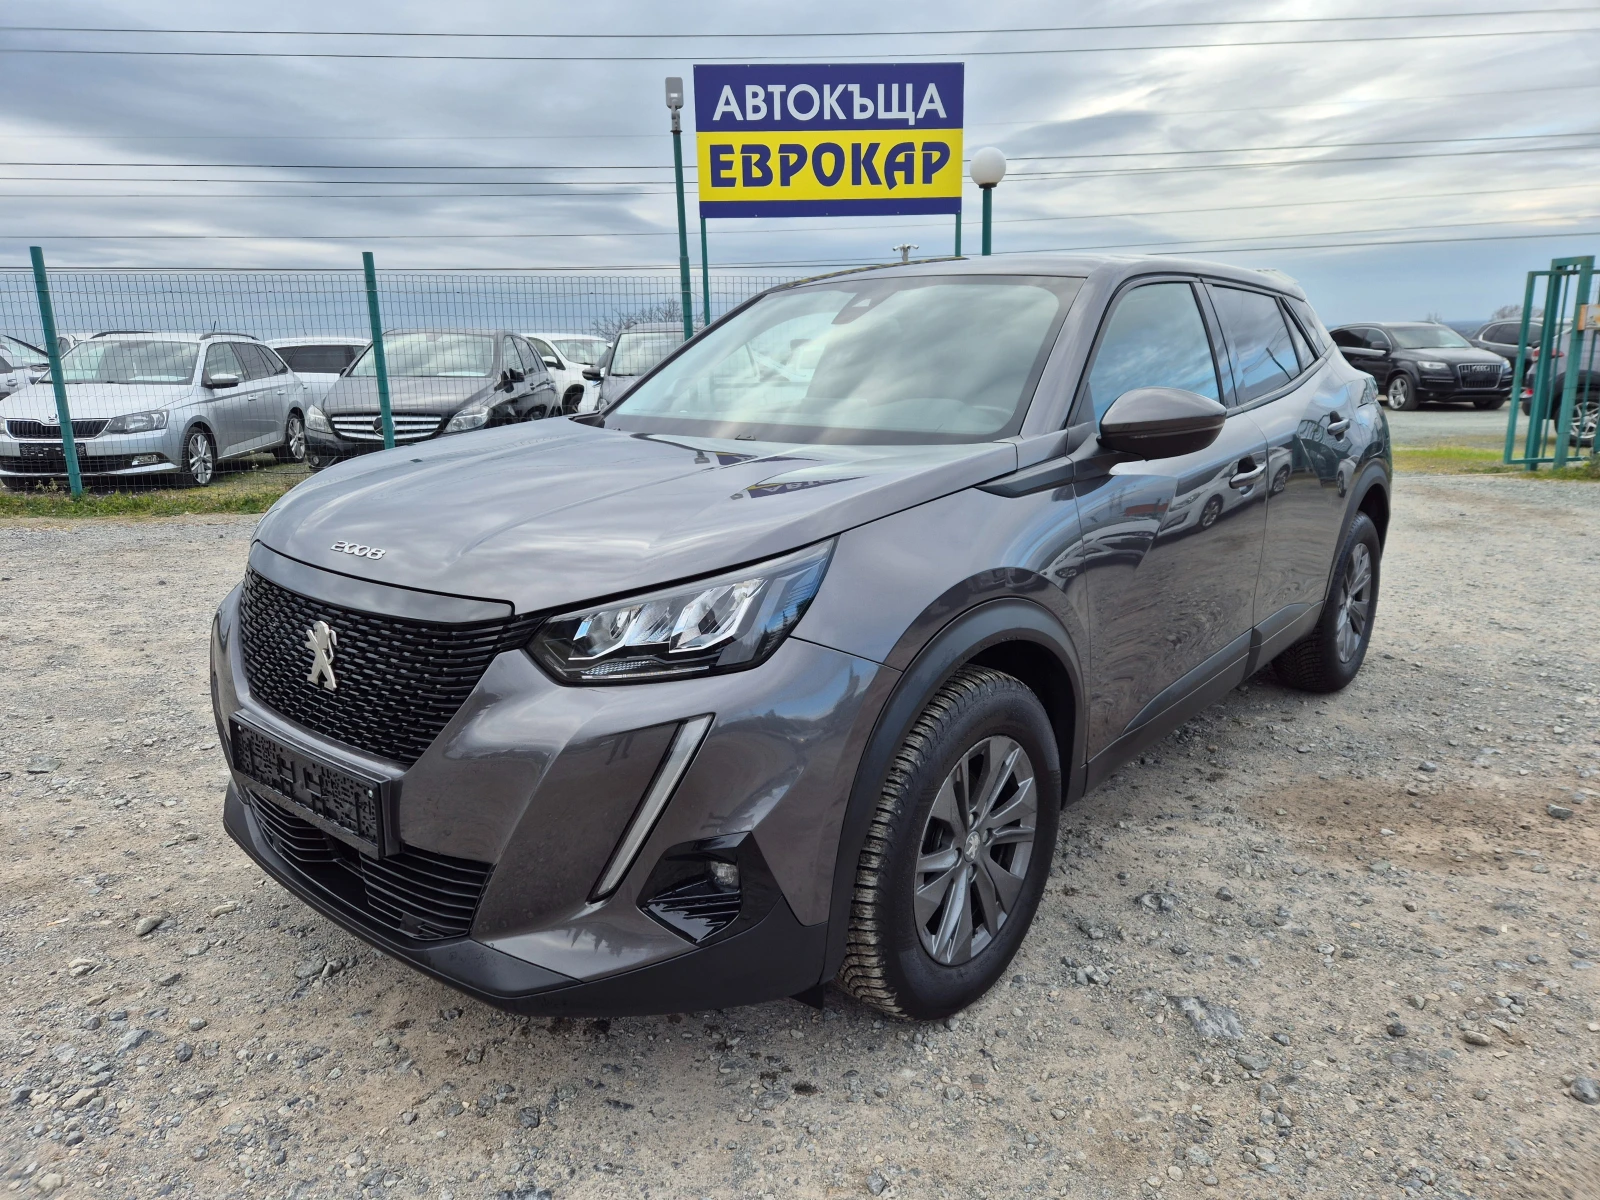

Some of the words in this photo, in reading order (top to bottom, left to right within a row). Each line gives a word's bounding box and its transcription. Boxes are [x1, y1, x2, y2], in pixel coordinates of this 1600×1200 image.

[712, 83, 947, 125] АВТОКЪЩА
[710, 142, 950, 190] ЕВРОКАР
[330, 540, 386, 560] 2008
